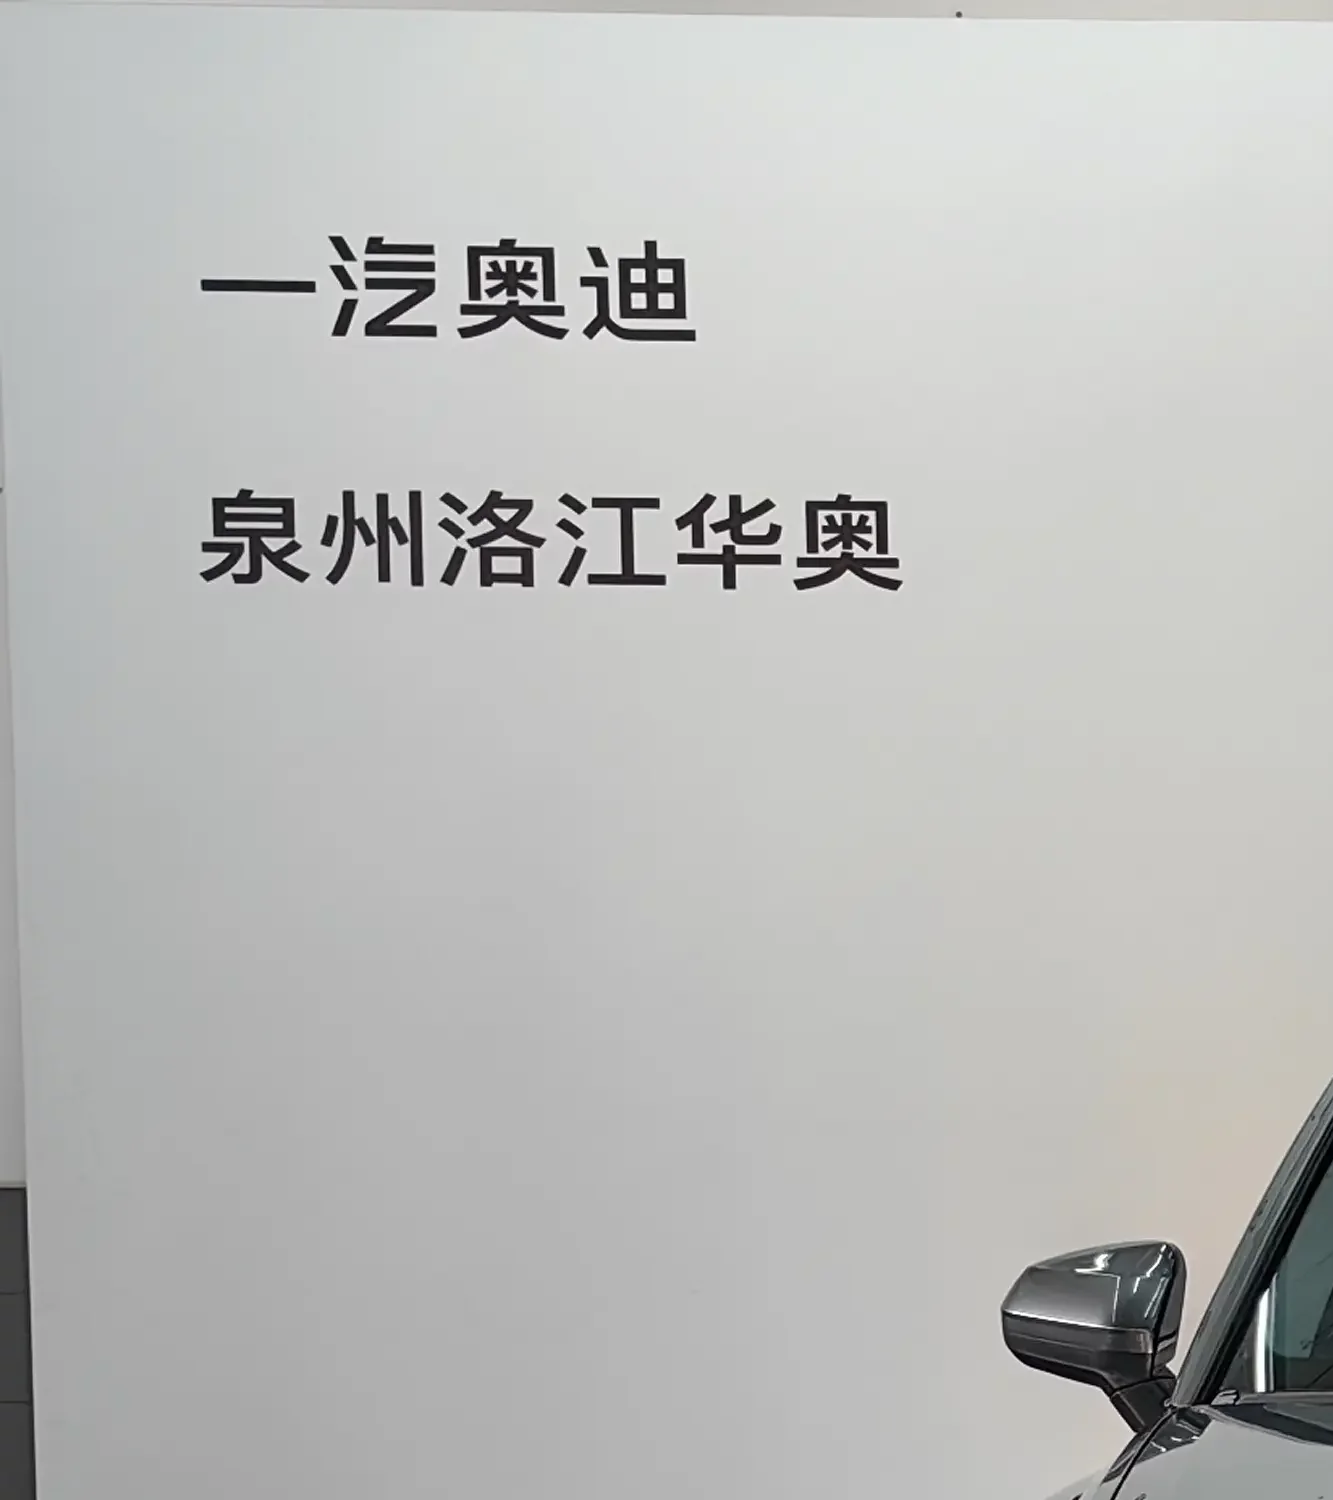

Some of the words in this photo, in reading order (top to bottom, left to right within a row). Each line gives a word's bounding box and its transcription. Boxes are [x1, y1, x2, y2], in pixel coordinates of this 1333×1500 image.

[200, 235, 697, 342] 一汽奥迪
[199, 488, 903, 591] 泉州洛江华奥
